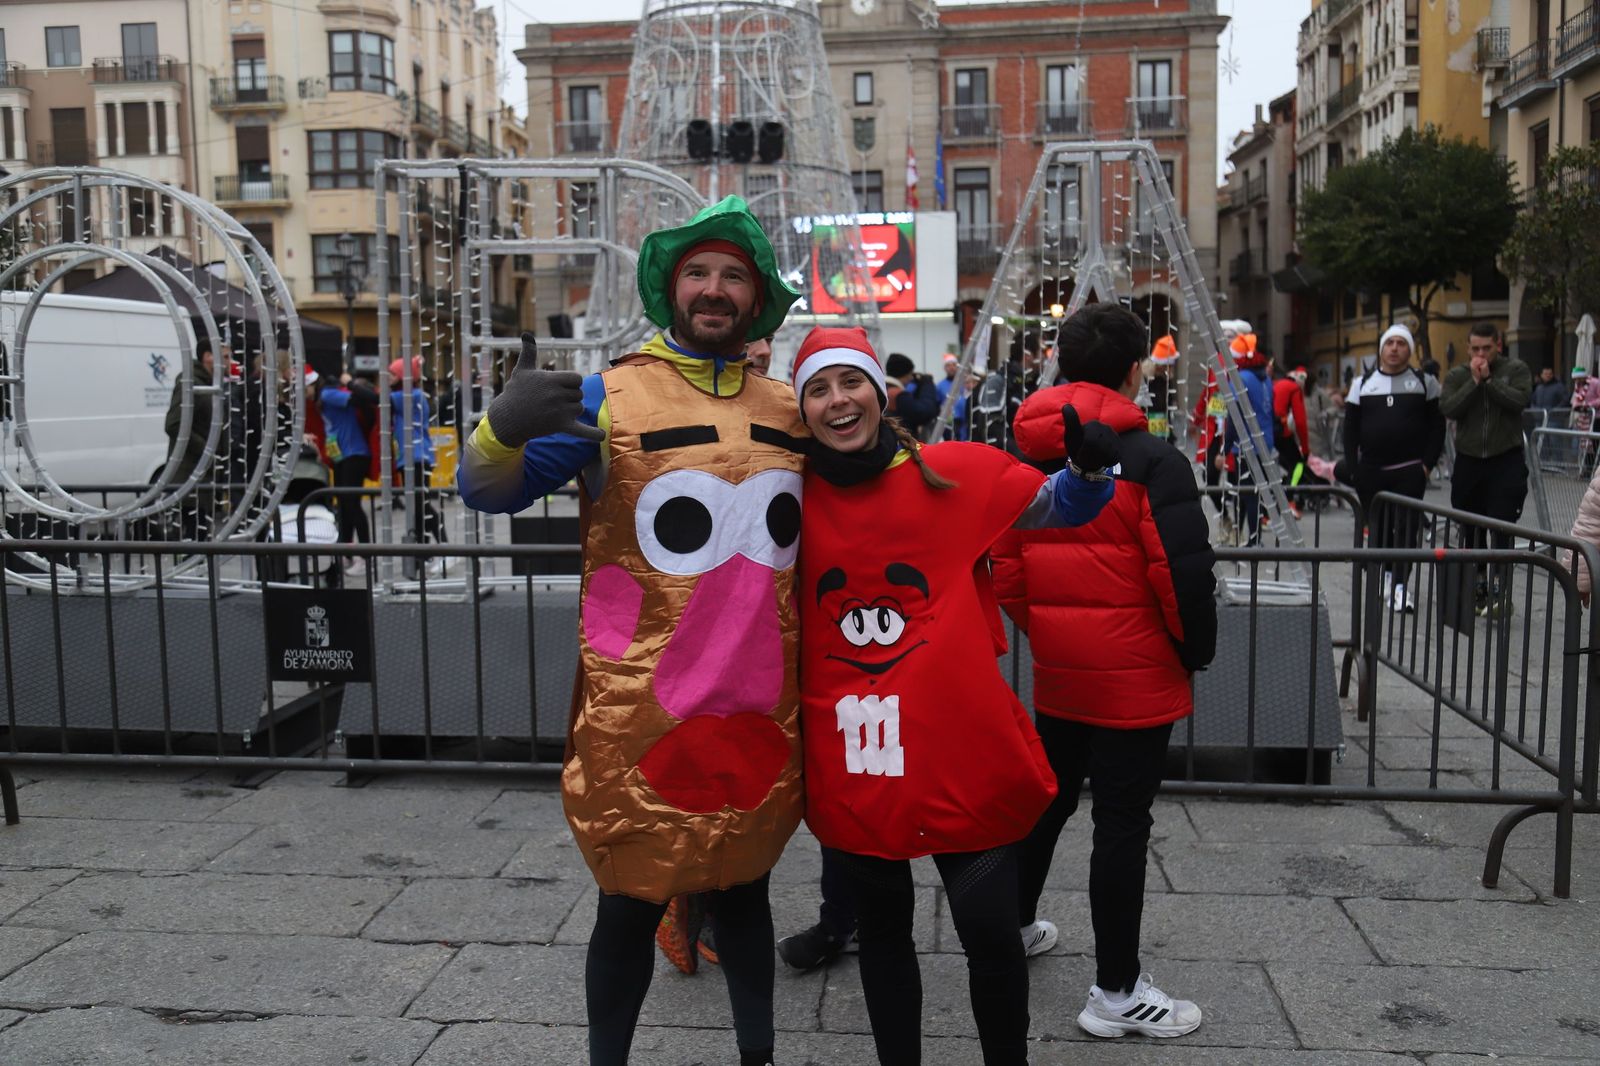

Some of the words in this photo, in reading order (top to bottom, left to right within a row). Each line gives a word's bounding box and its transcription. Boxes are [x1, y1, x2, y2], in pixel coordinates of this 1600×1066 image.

[1386, 395, 1394, 407] 9
[283, 649, 354, 660] AYUNTAMIENTO
[283, 658, 299, 670] DE
[302, 658, 354, 671] ZAMORA
